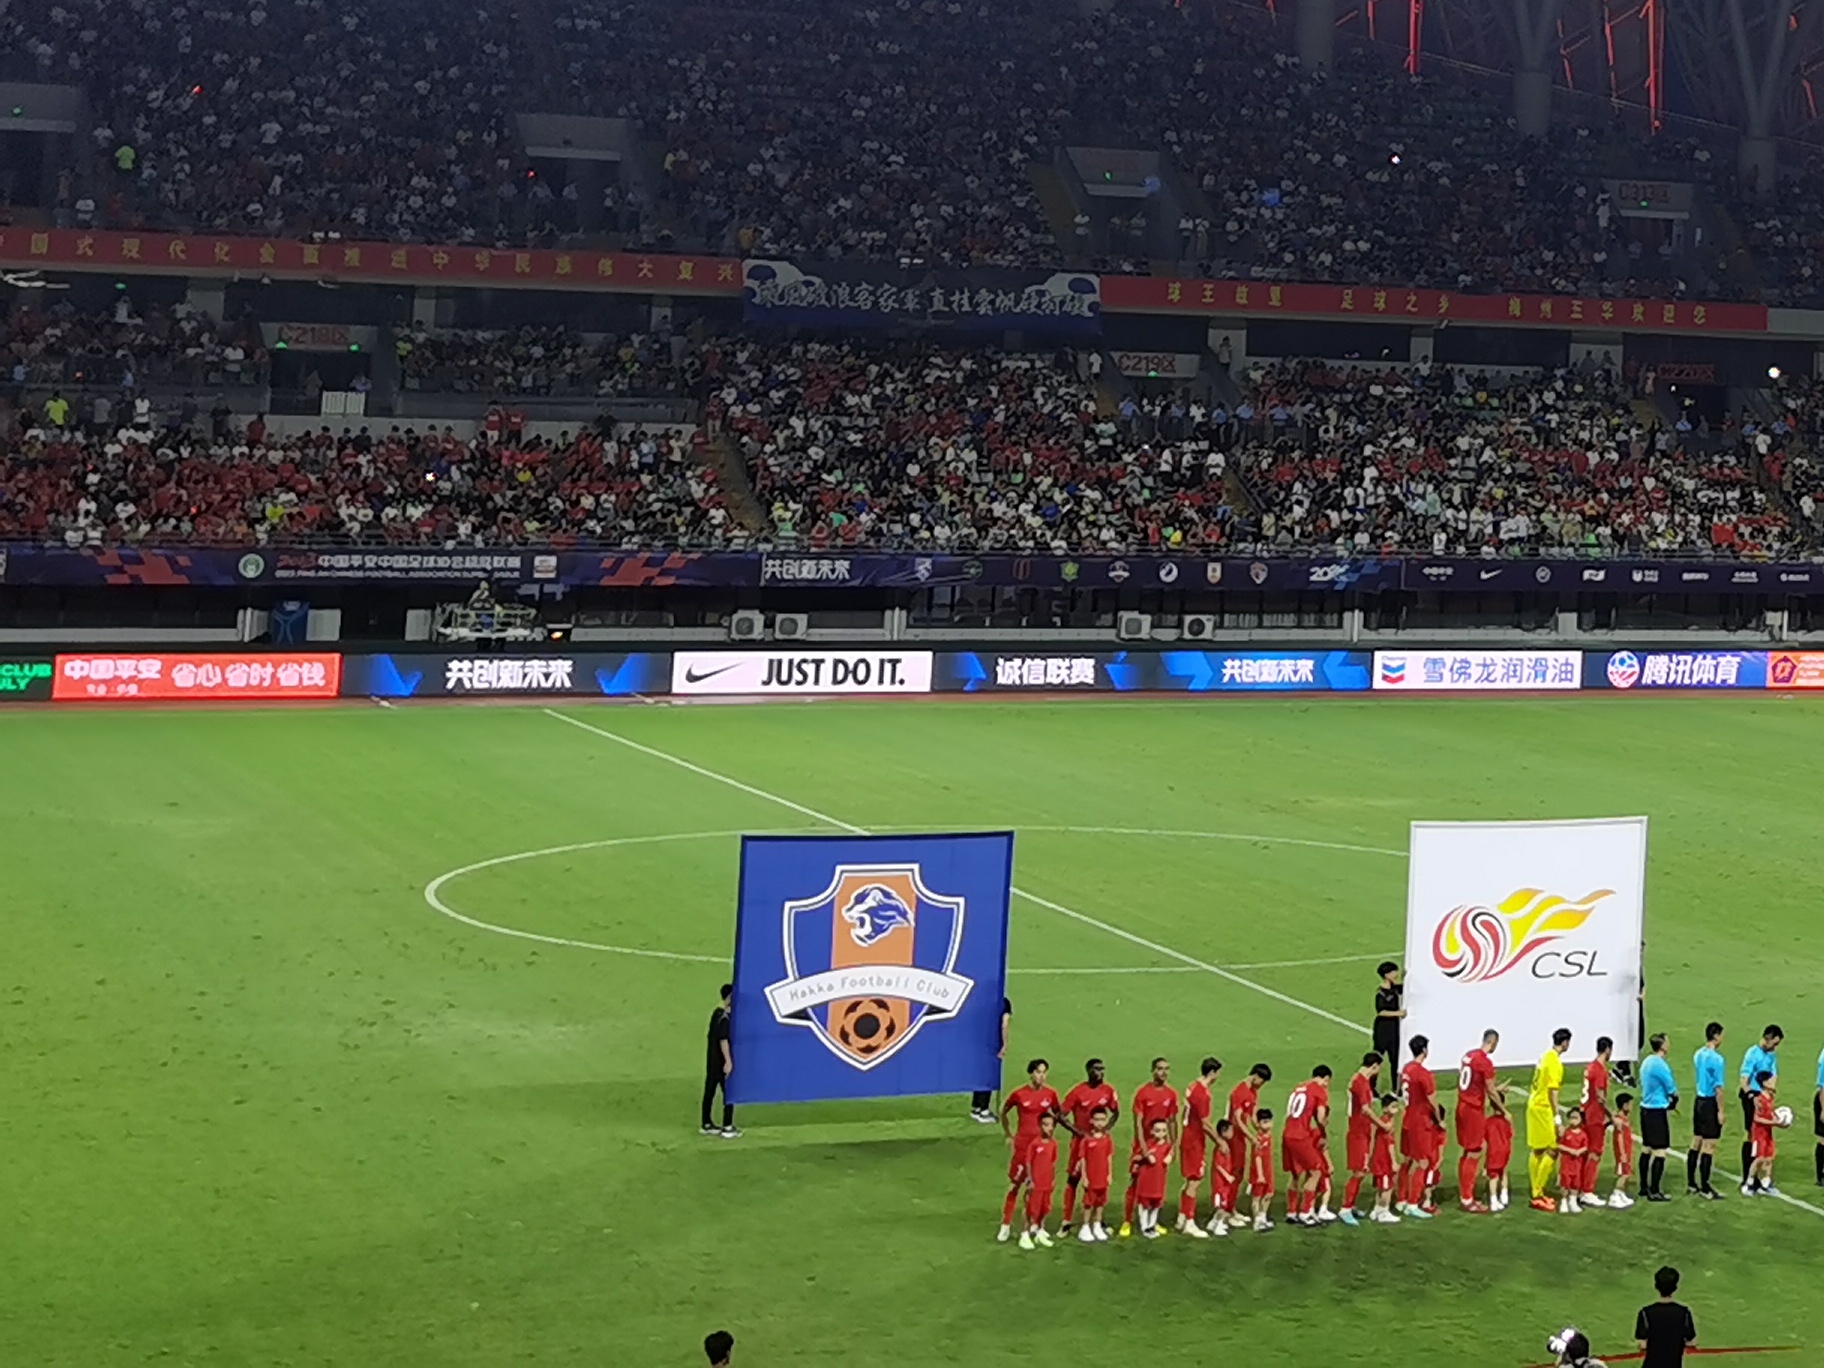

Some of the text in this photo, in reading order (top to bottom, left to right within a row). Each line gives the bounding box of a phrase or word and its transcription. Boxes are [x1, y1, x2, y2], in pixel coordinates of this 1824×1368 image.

[0, 232, 733, 281] 国式现代化全面推进中华民族伟大复兴
[65, 659, 162, 680] 中国平安
[444, 659, 573, 690] 共创新未来
[761, 658, 905, 687] JUST DO IT.
[995, 656, 1096, 685] 诚信联赛
[1221, 658, 1315, 683] 共创新未来
[1422, 657, 1575, 685] 雪佛龙润滑油
[1641, 651, 1741, 685] 腾讯体育
[1531, 950, 1608, 979] CSL
[788, 974, 950, 1002] Hakka Football Club
[1287, 1091, 1307, 1119] 10
